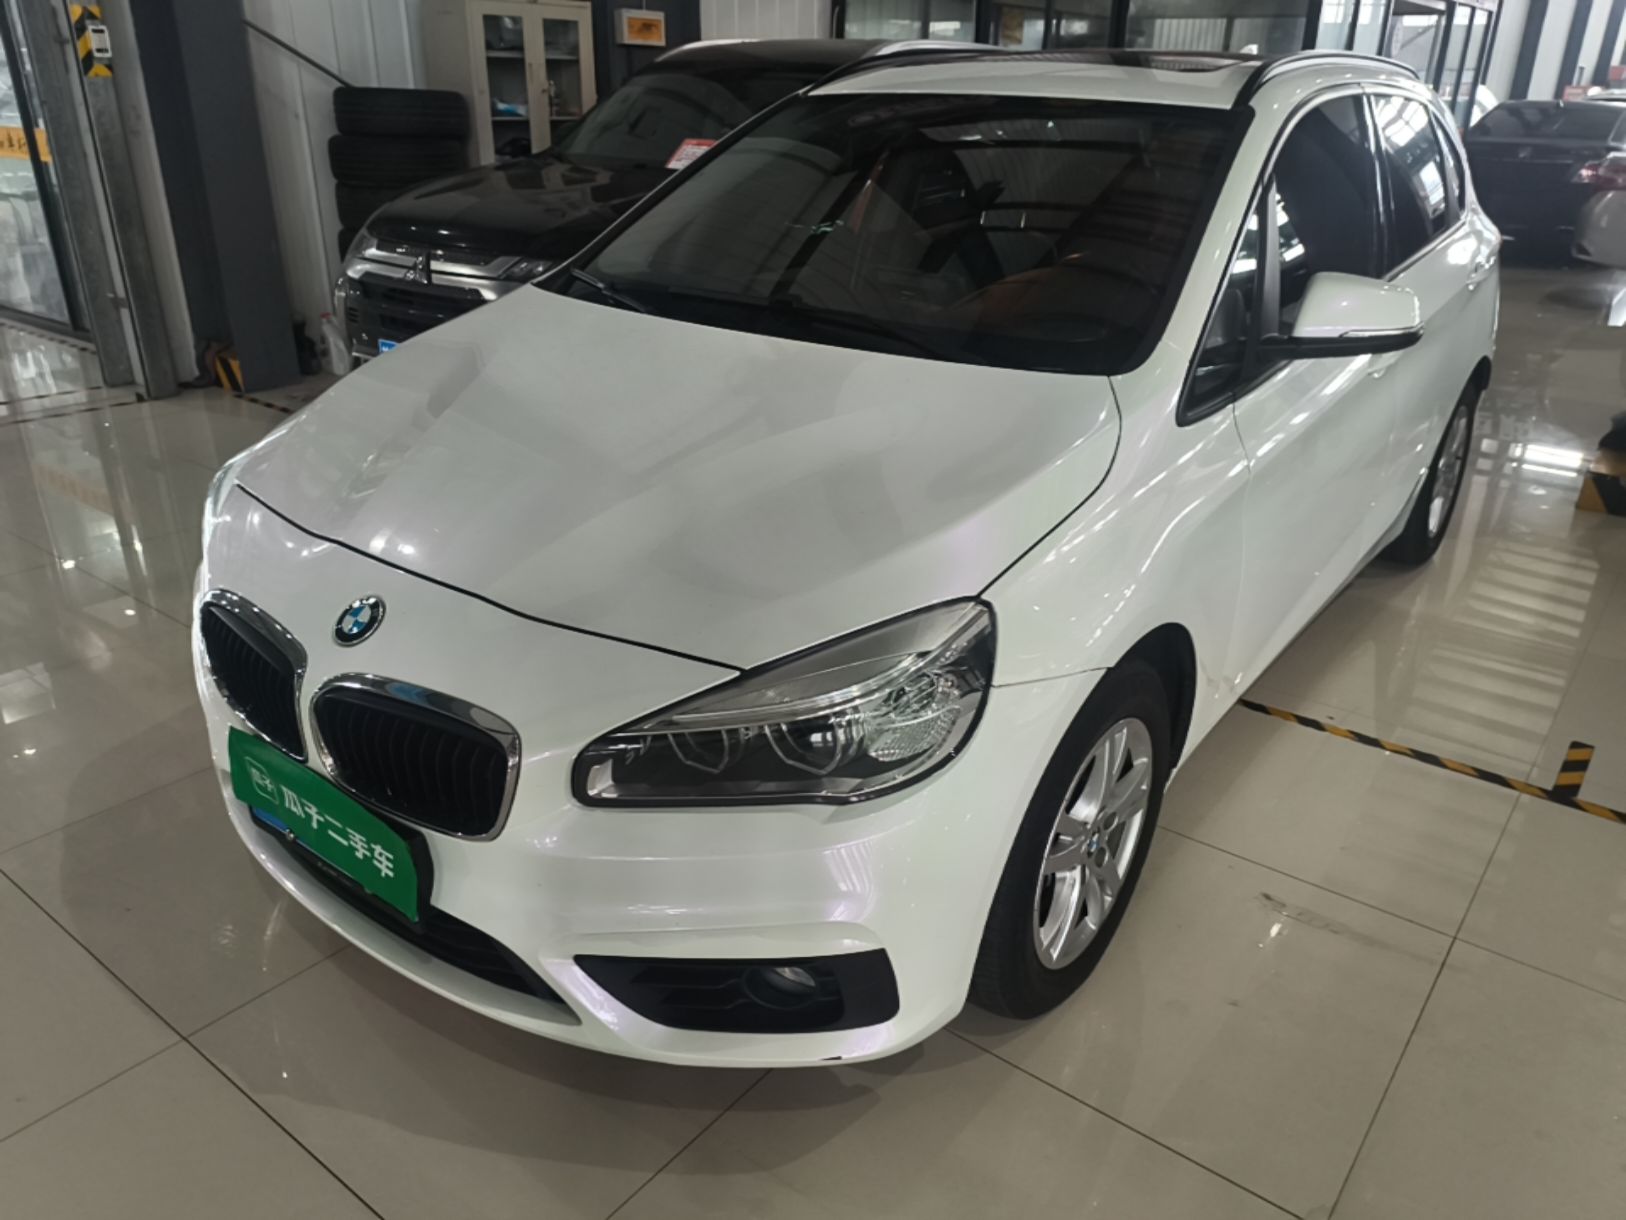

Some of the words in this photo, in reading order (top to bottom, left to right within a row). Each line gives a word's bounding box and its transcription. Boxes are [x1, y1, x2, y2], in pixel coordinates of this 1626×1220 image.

[279, 784, 394, 878] 瓜子二手车
